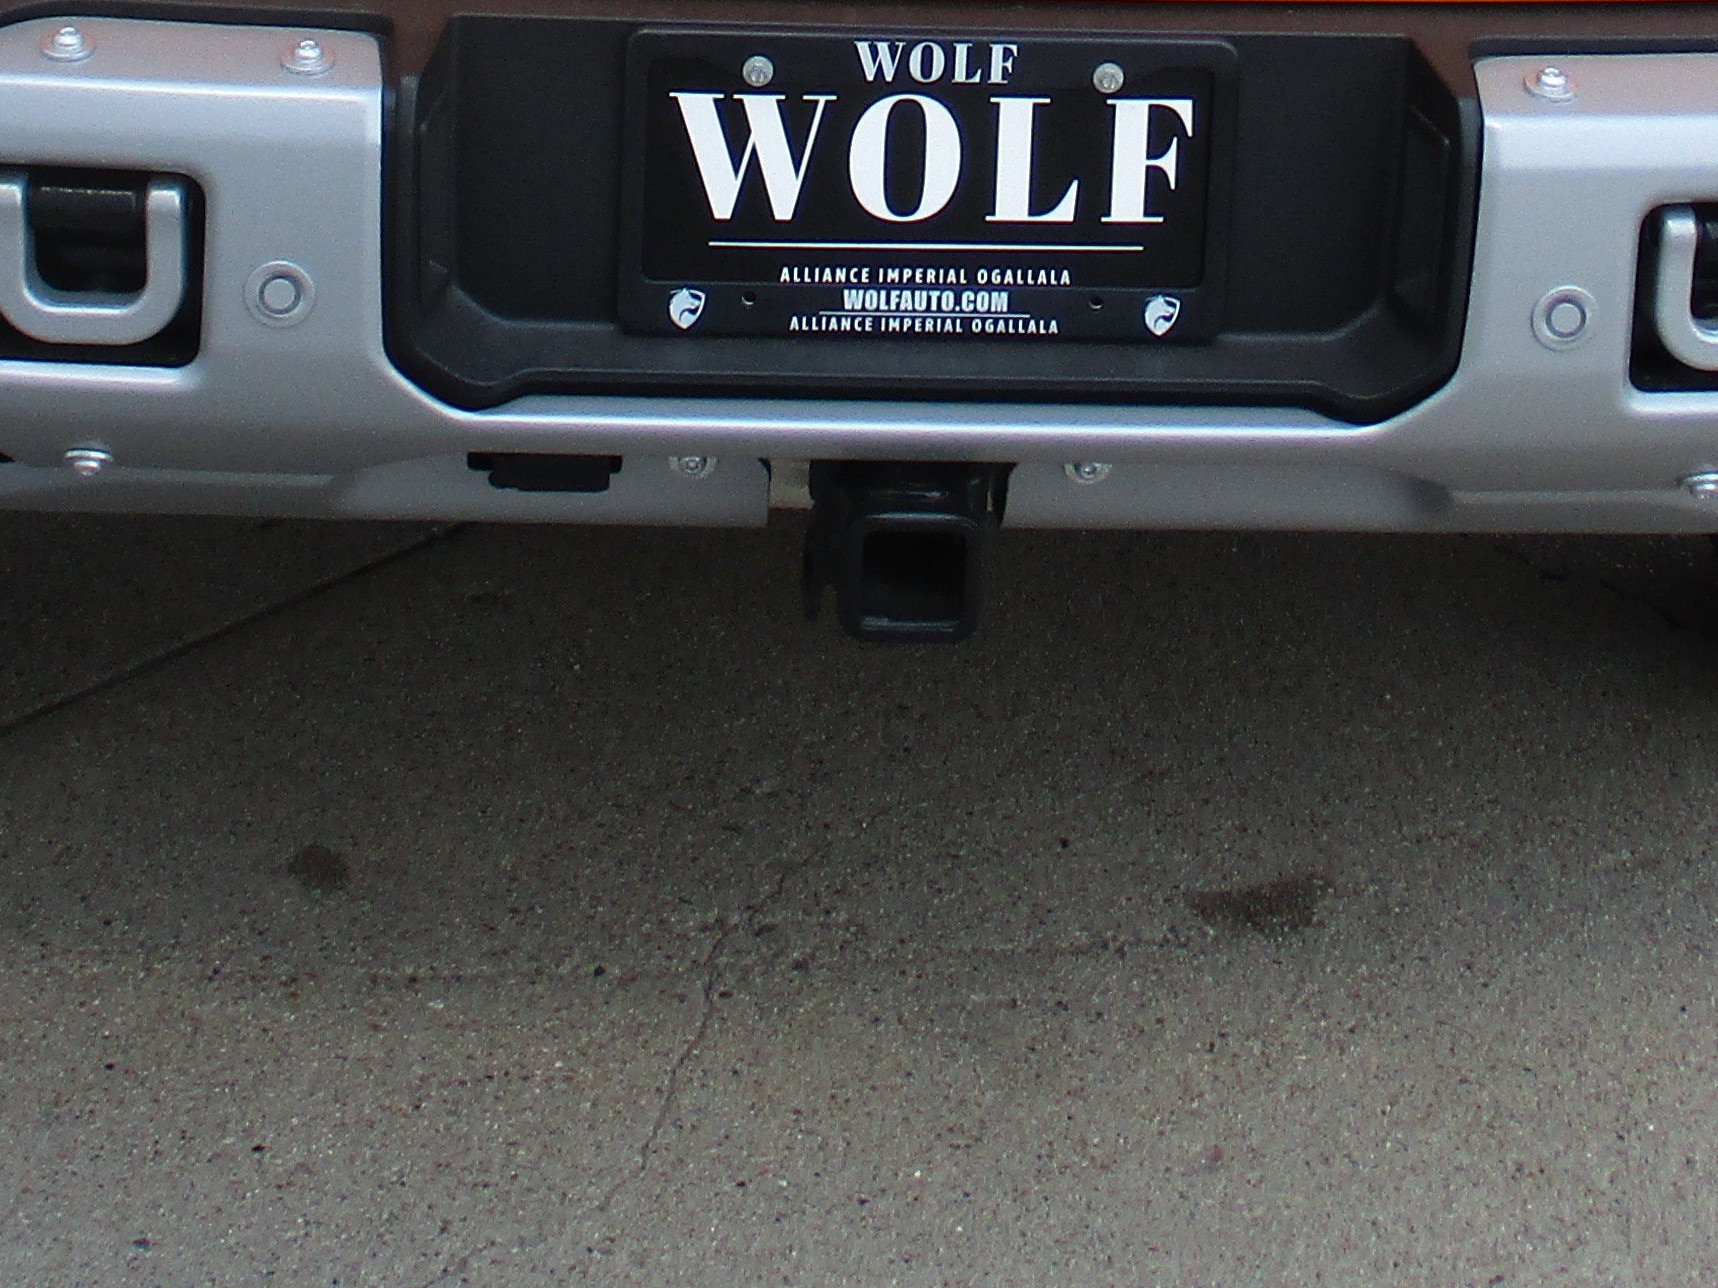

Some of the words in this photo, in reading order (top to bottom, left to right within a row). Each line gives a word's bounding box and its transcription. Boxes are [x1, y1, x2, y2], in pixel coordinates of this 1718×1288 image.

[853, 40, 1019, 85] WOLF
[668, 91, 1194, 224] WOLF
[779, 265, 871, 284] ALLIANCE
[878, 267, 968, 285] IMPERIAL
[976, 268, 1072, 286] OGALLALA
[842, 288, 1010, 313] WOLFAUTO.COM
[788, 315, 873, 332] ALLIANCE
[880, 316, 964, 333] IMPERIAL
[970, 318, 1060, 335] OGALLALA
